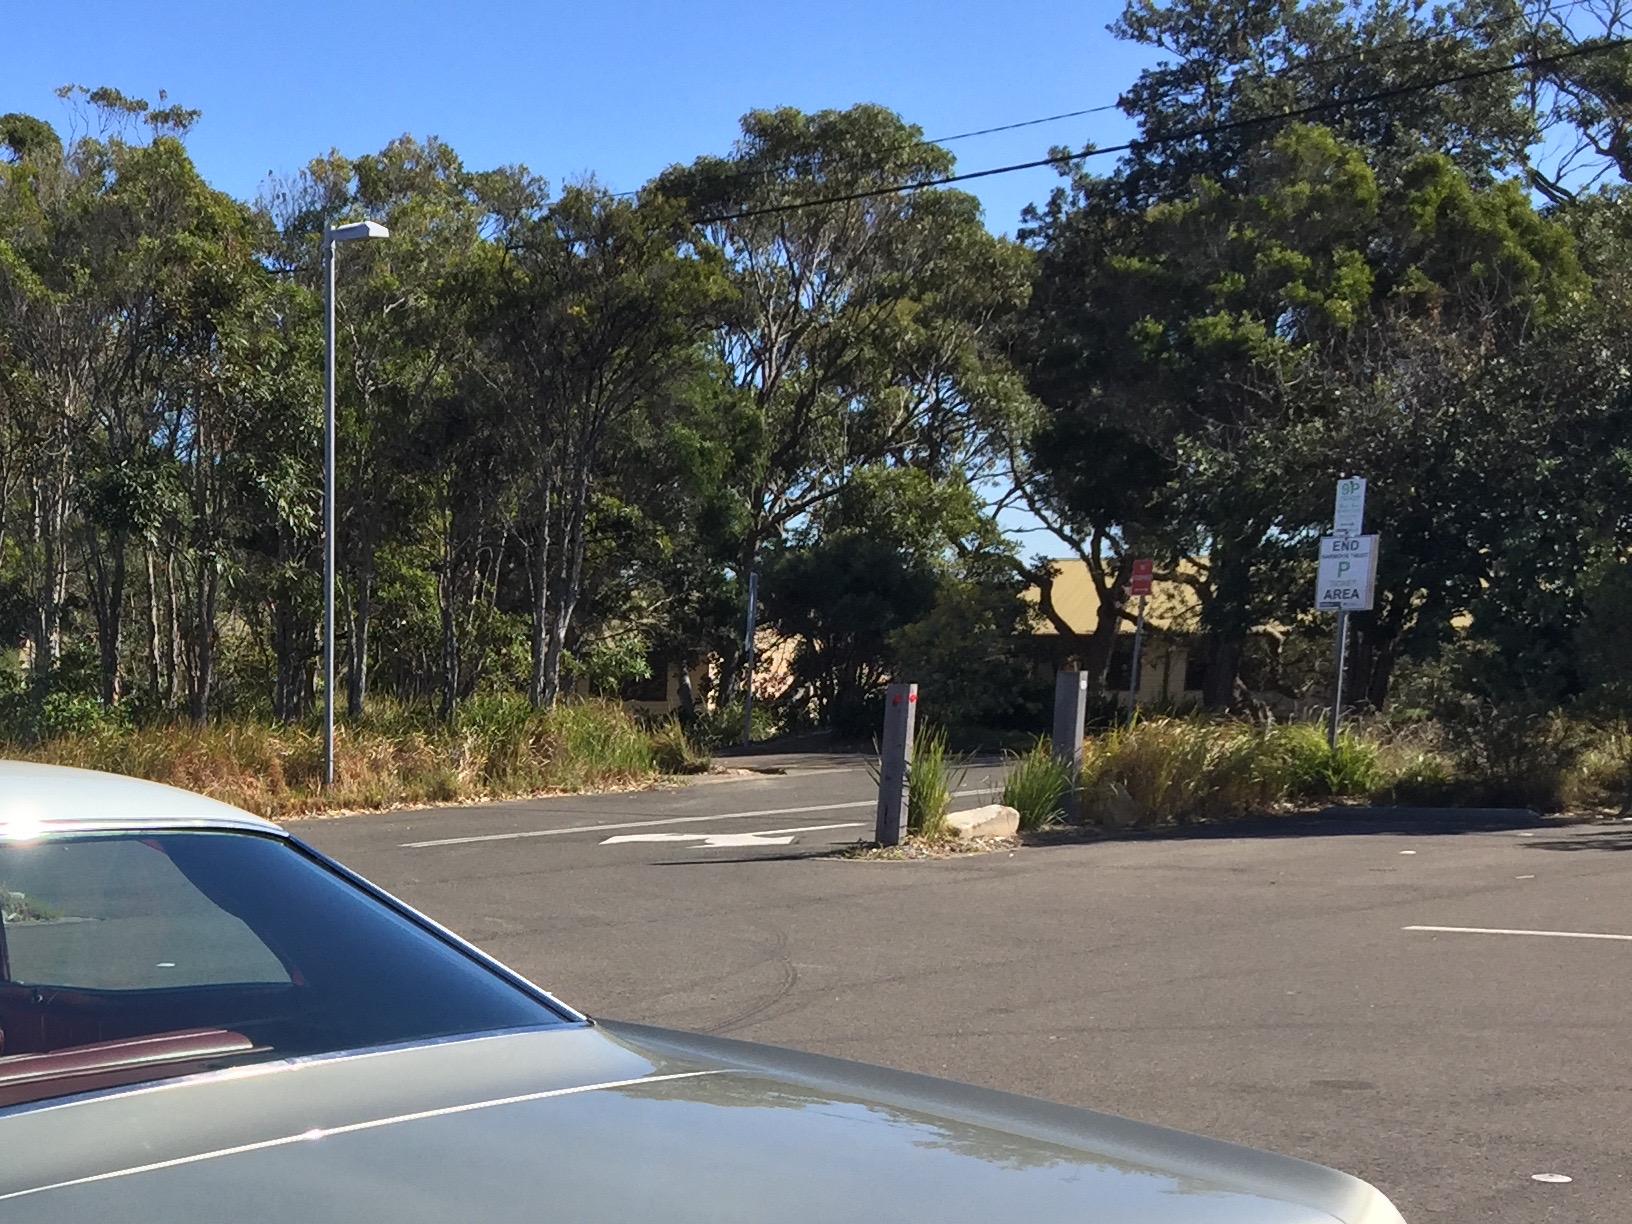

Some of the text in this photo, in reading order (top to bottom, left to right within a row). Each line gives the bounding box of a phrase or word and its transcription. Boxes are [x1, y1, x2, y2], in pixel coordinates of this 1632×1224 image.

[1332, 541, 1359, 552] END
[1337, 561, 1351, 578] P
[1324, 588, 1360, 600] AREA
